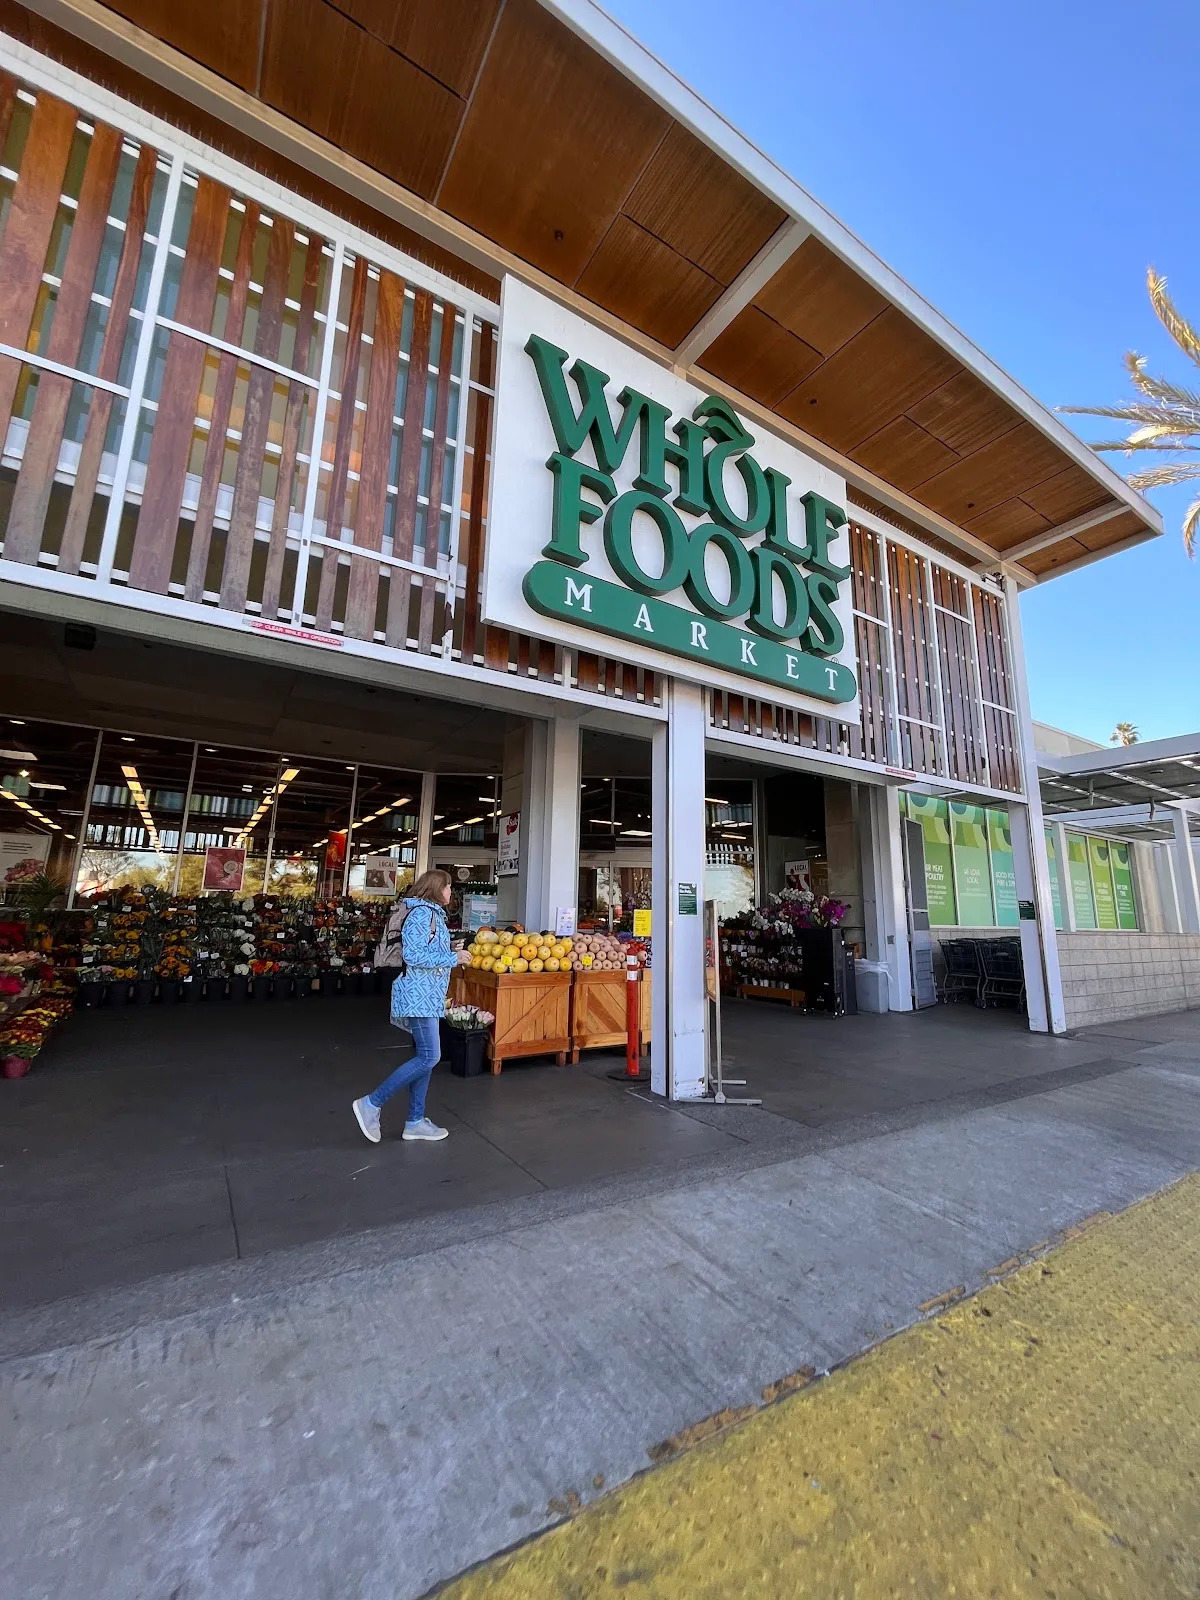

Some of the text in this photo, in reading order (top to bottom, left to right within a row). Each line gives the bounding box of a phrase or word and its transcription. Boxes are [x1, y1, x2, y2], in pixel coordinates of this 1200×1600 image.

[524, 333, 851, 580] WHOLE
[542, 452, 844, 657] FOODS
[564, 576, 839, 691] MARKET
[378, 860, 394, 868] LOCAL
